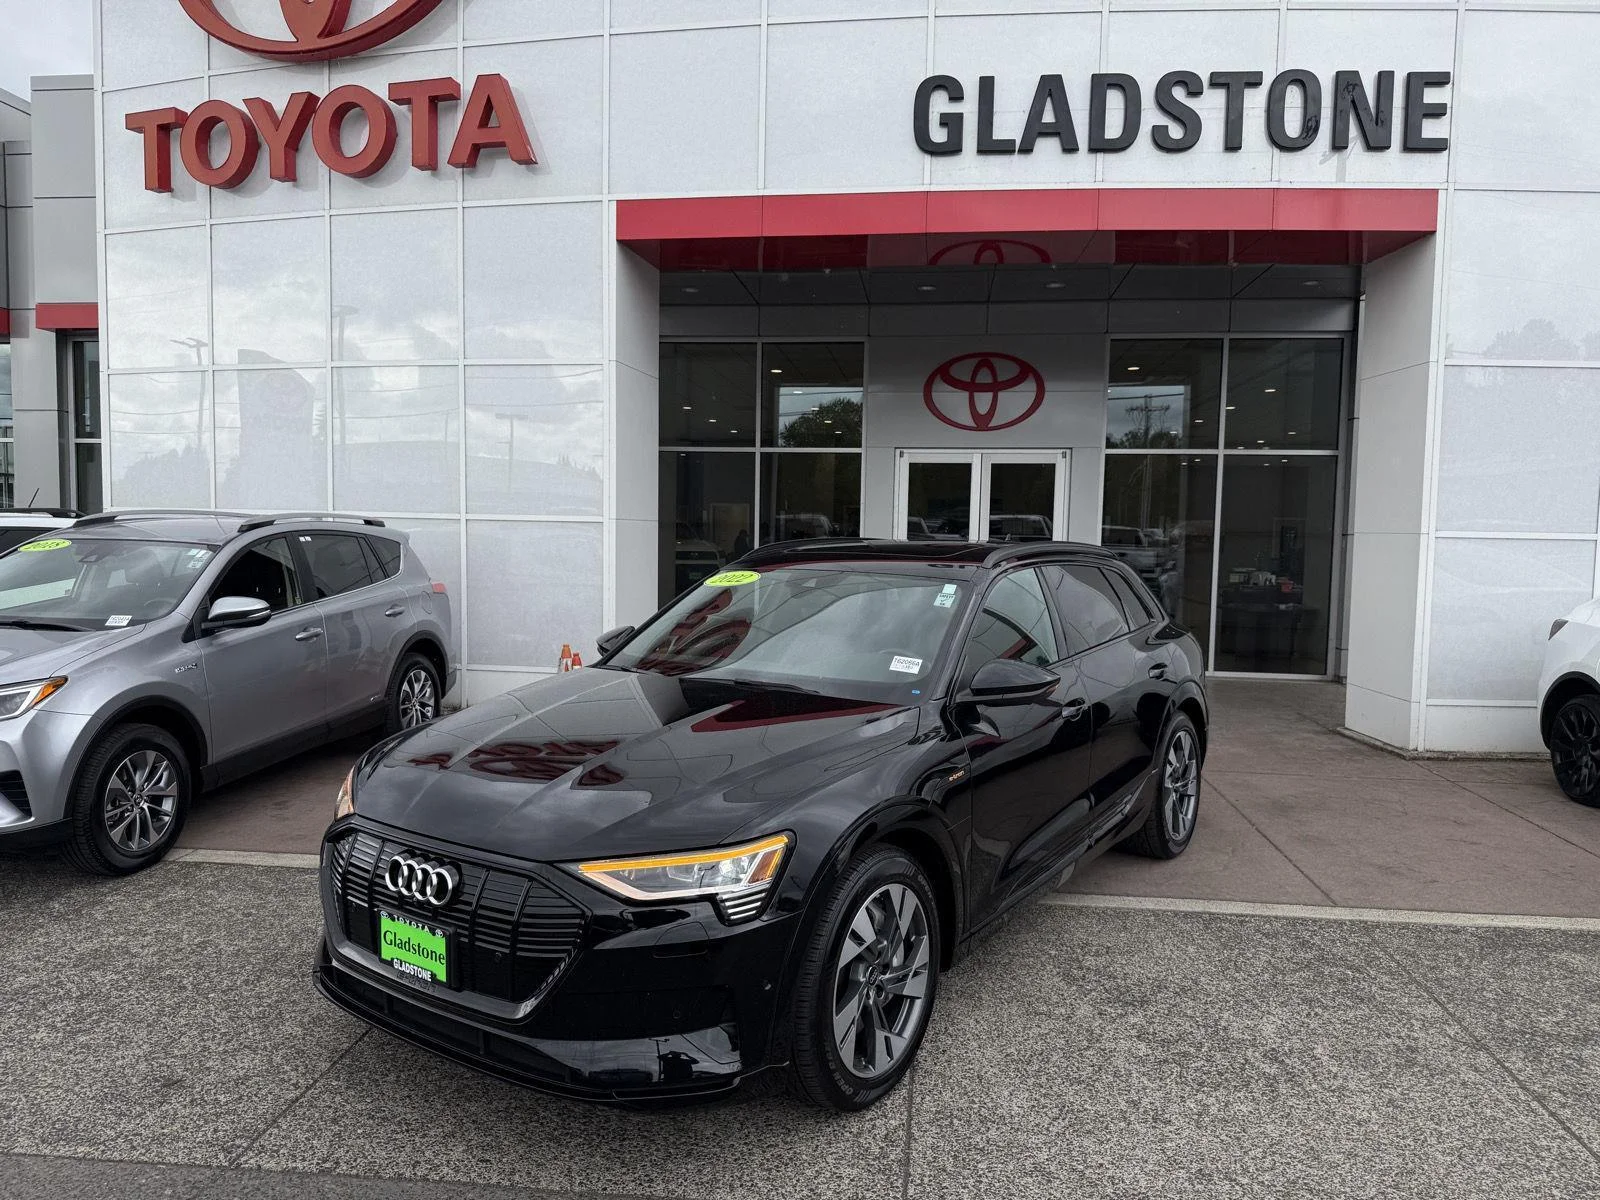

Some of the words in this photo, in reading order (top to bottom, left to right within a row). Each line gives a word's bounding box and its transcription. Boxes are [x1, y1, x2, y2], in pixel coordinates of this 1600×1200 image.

[913, 69, 1451, 154] GLADSTONE
[125, 73, 538, 193] TOYOTA
[710, 573, 754, 584] 2022
[393, 914, 430, 933] TOYOTA
[383, 930, 445, 965] Gladstone
[393, 958, 432, 982] GLADSTONE
